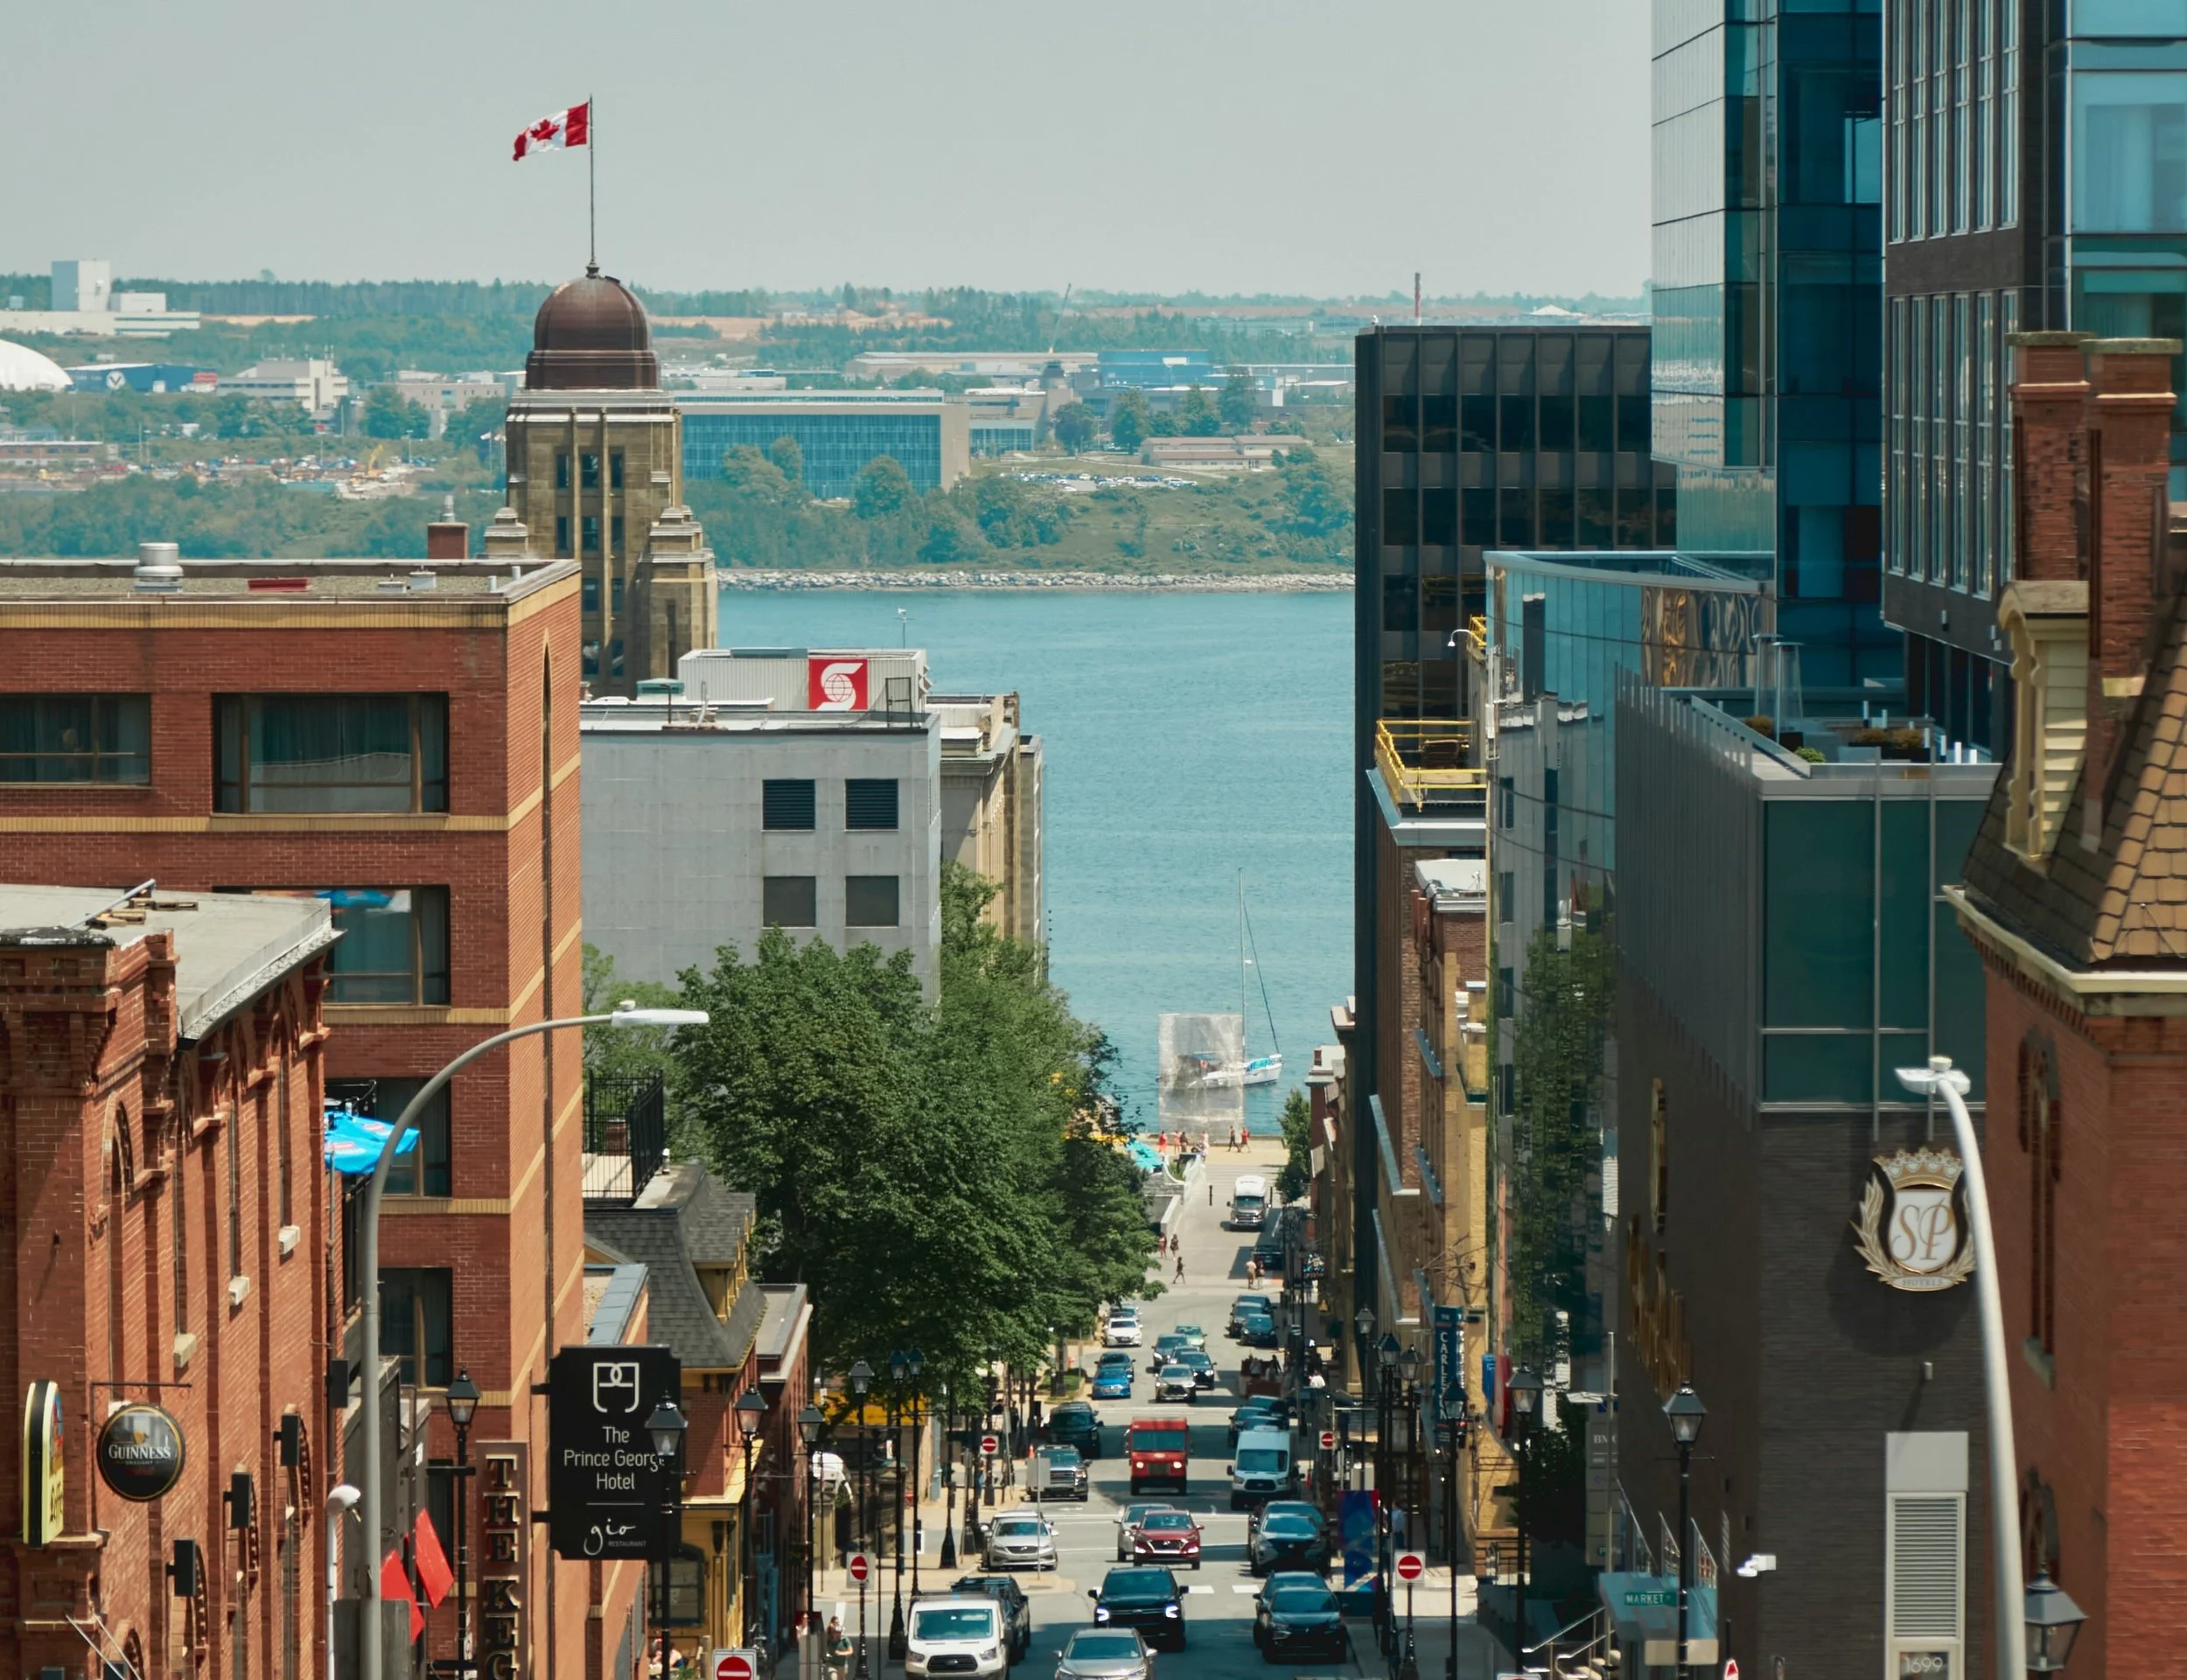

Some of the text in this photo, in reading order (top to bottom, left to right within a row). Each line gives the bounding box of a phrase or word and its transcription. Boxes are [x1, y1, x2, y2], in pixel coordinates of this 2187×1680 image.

[602, 1426, 630, 1443] The
[108, 1444, 171, 1460] GUINNESS
[563, 1449, 610, 1467] Prince
[596, 1473, 636, 1490] Hotel
[483, 1453, 521, 1563] THE
[583, 1518, 637, 1556] gio
[1625, 1593, 1665, 1605] MARKET
[483, 1575, 521, 1680] KEG
[1904, 1656, 1943, 1674] 1699
